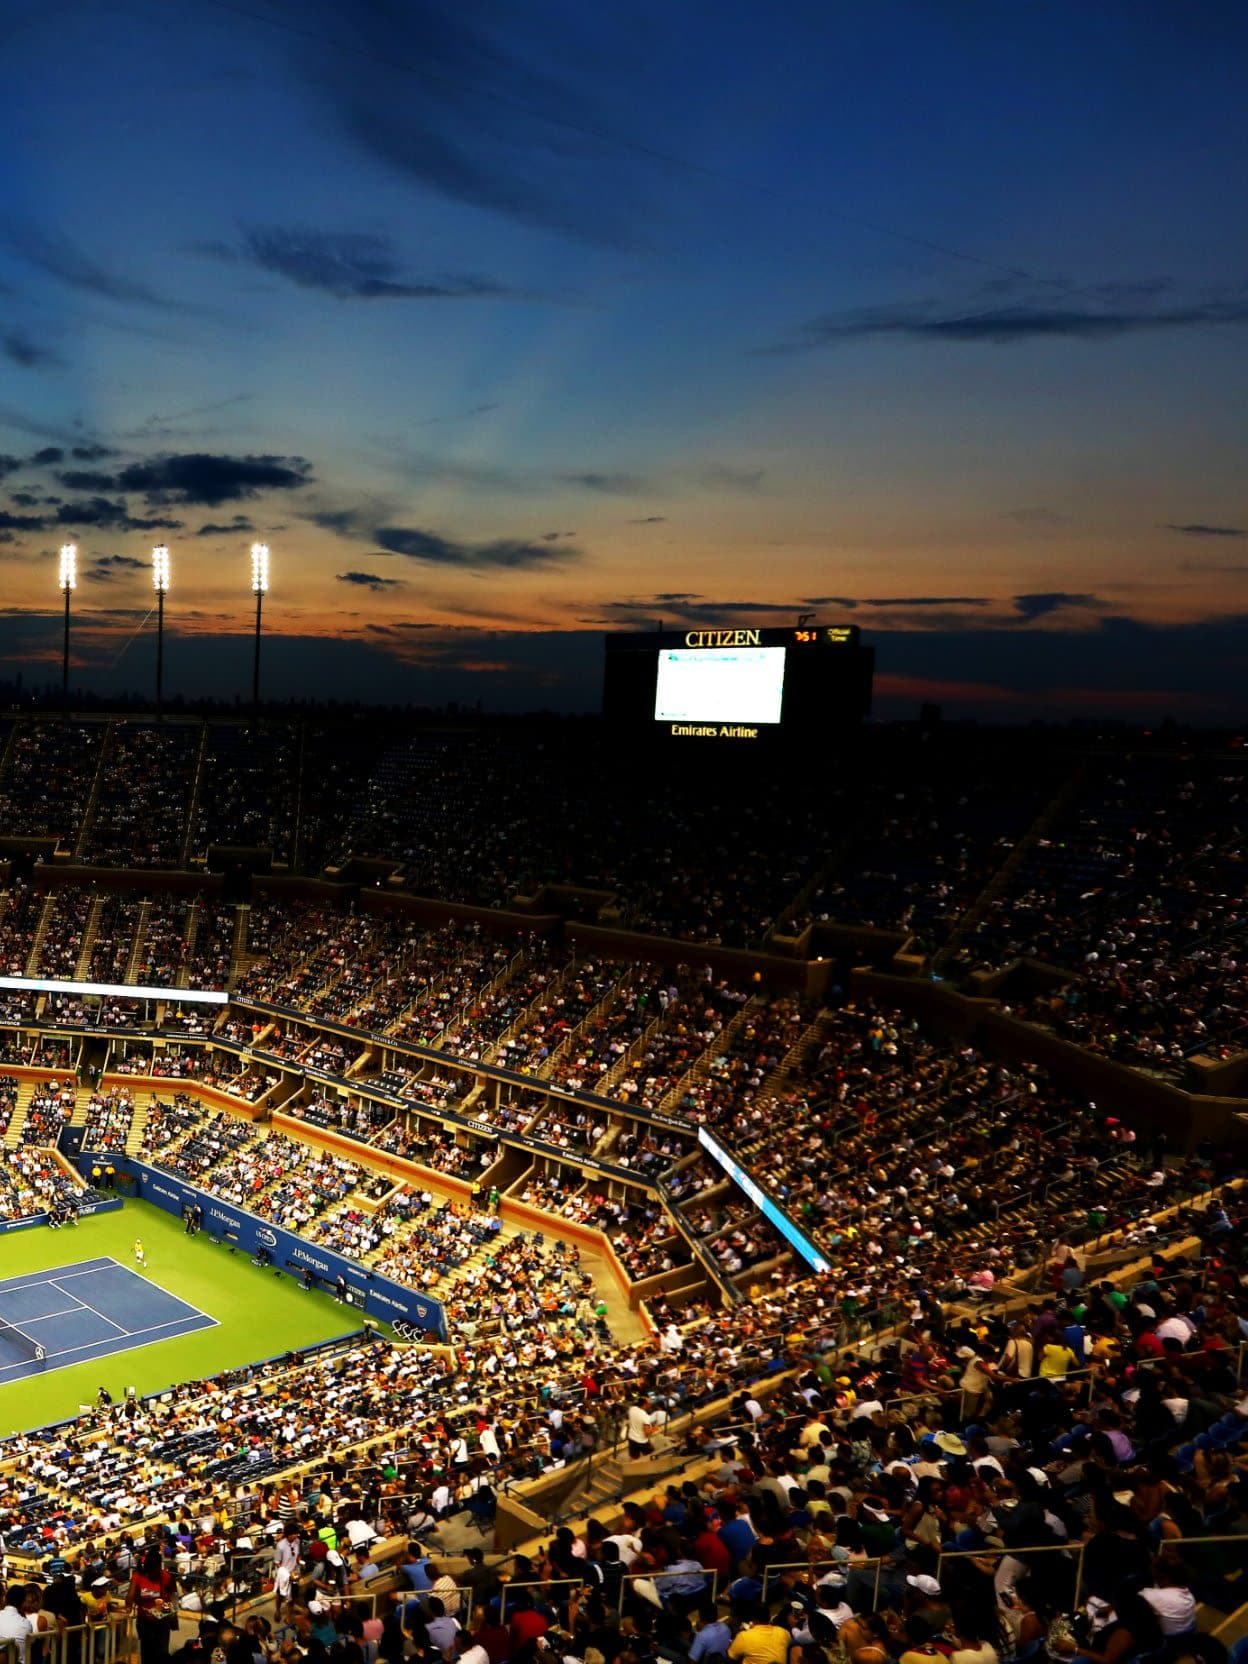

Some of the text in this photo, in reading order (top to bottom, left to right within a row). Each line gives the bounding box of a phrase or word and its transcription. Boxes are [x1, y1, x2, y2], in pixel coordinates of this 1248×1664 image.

[685, 629, 760, 647] CITIZEN
[671, 724, 759, 738] Emirates Airline
[467, 1120, 493, 1133] CITIZEN
